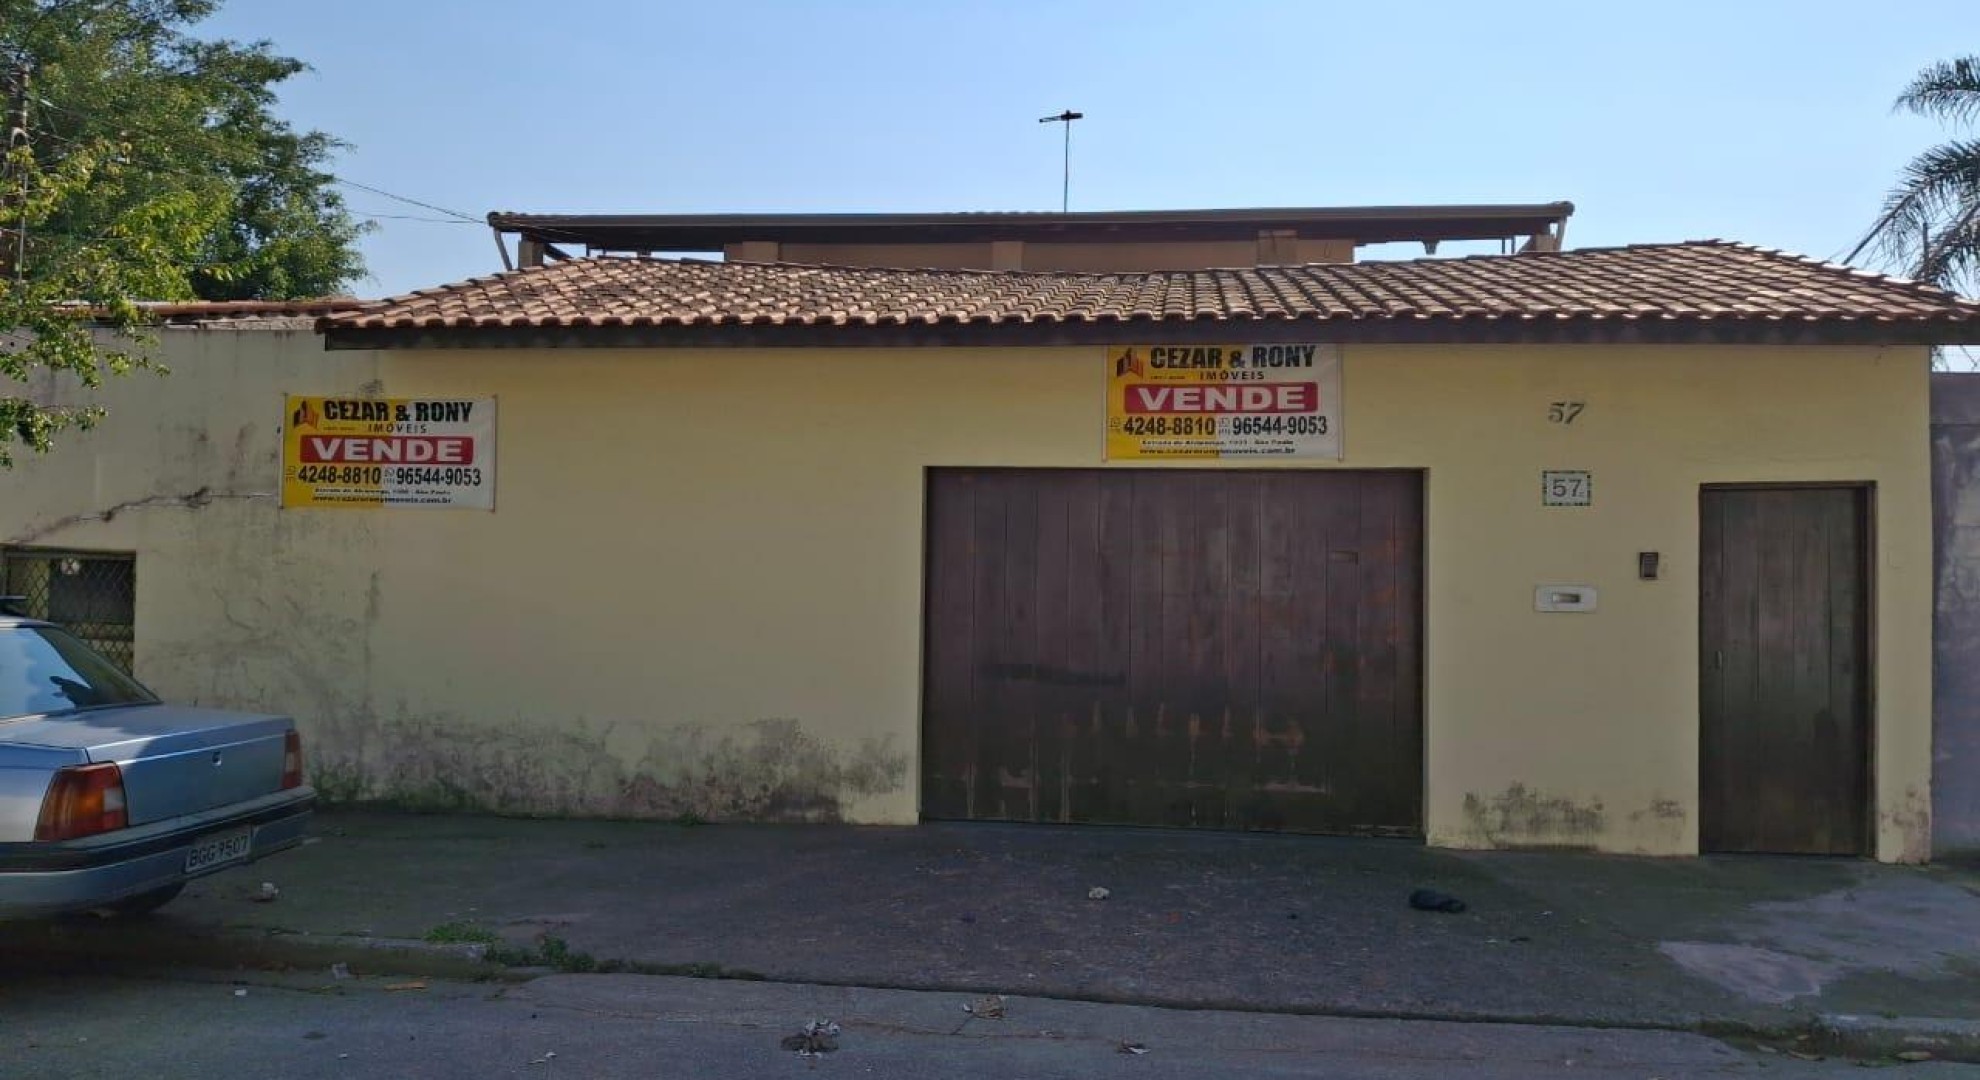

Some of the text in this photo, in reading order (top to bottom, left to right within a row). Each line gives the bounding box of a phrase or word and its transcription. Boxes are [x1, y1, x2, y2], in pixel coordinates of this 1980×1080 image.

[1150, 345, 1316, 369] CEZAR & RONY
[1200, 370, 1265, 380] IMÓVEIS
[1138, 386, 1305, 411] VENDE
[324, 400, 474, 422] CEZAR & RONY
[1547, 402, 1585, 424] 57
[1123, 416, 1215, 436] 4248-8810
[1232, 415, 1328, 436] 96544-9053
[311, 437, 463, 462] VENDE
[298, 465, 381, 484] 4248-8810
[397, 467, 482, 486] 96544-9053
[1552, 478, 1582, 498] 57
